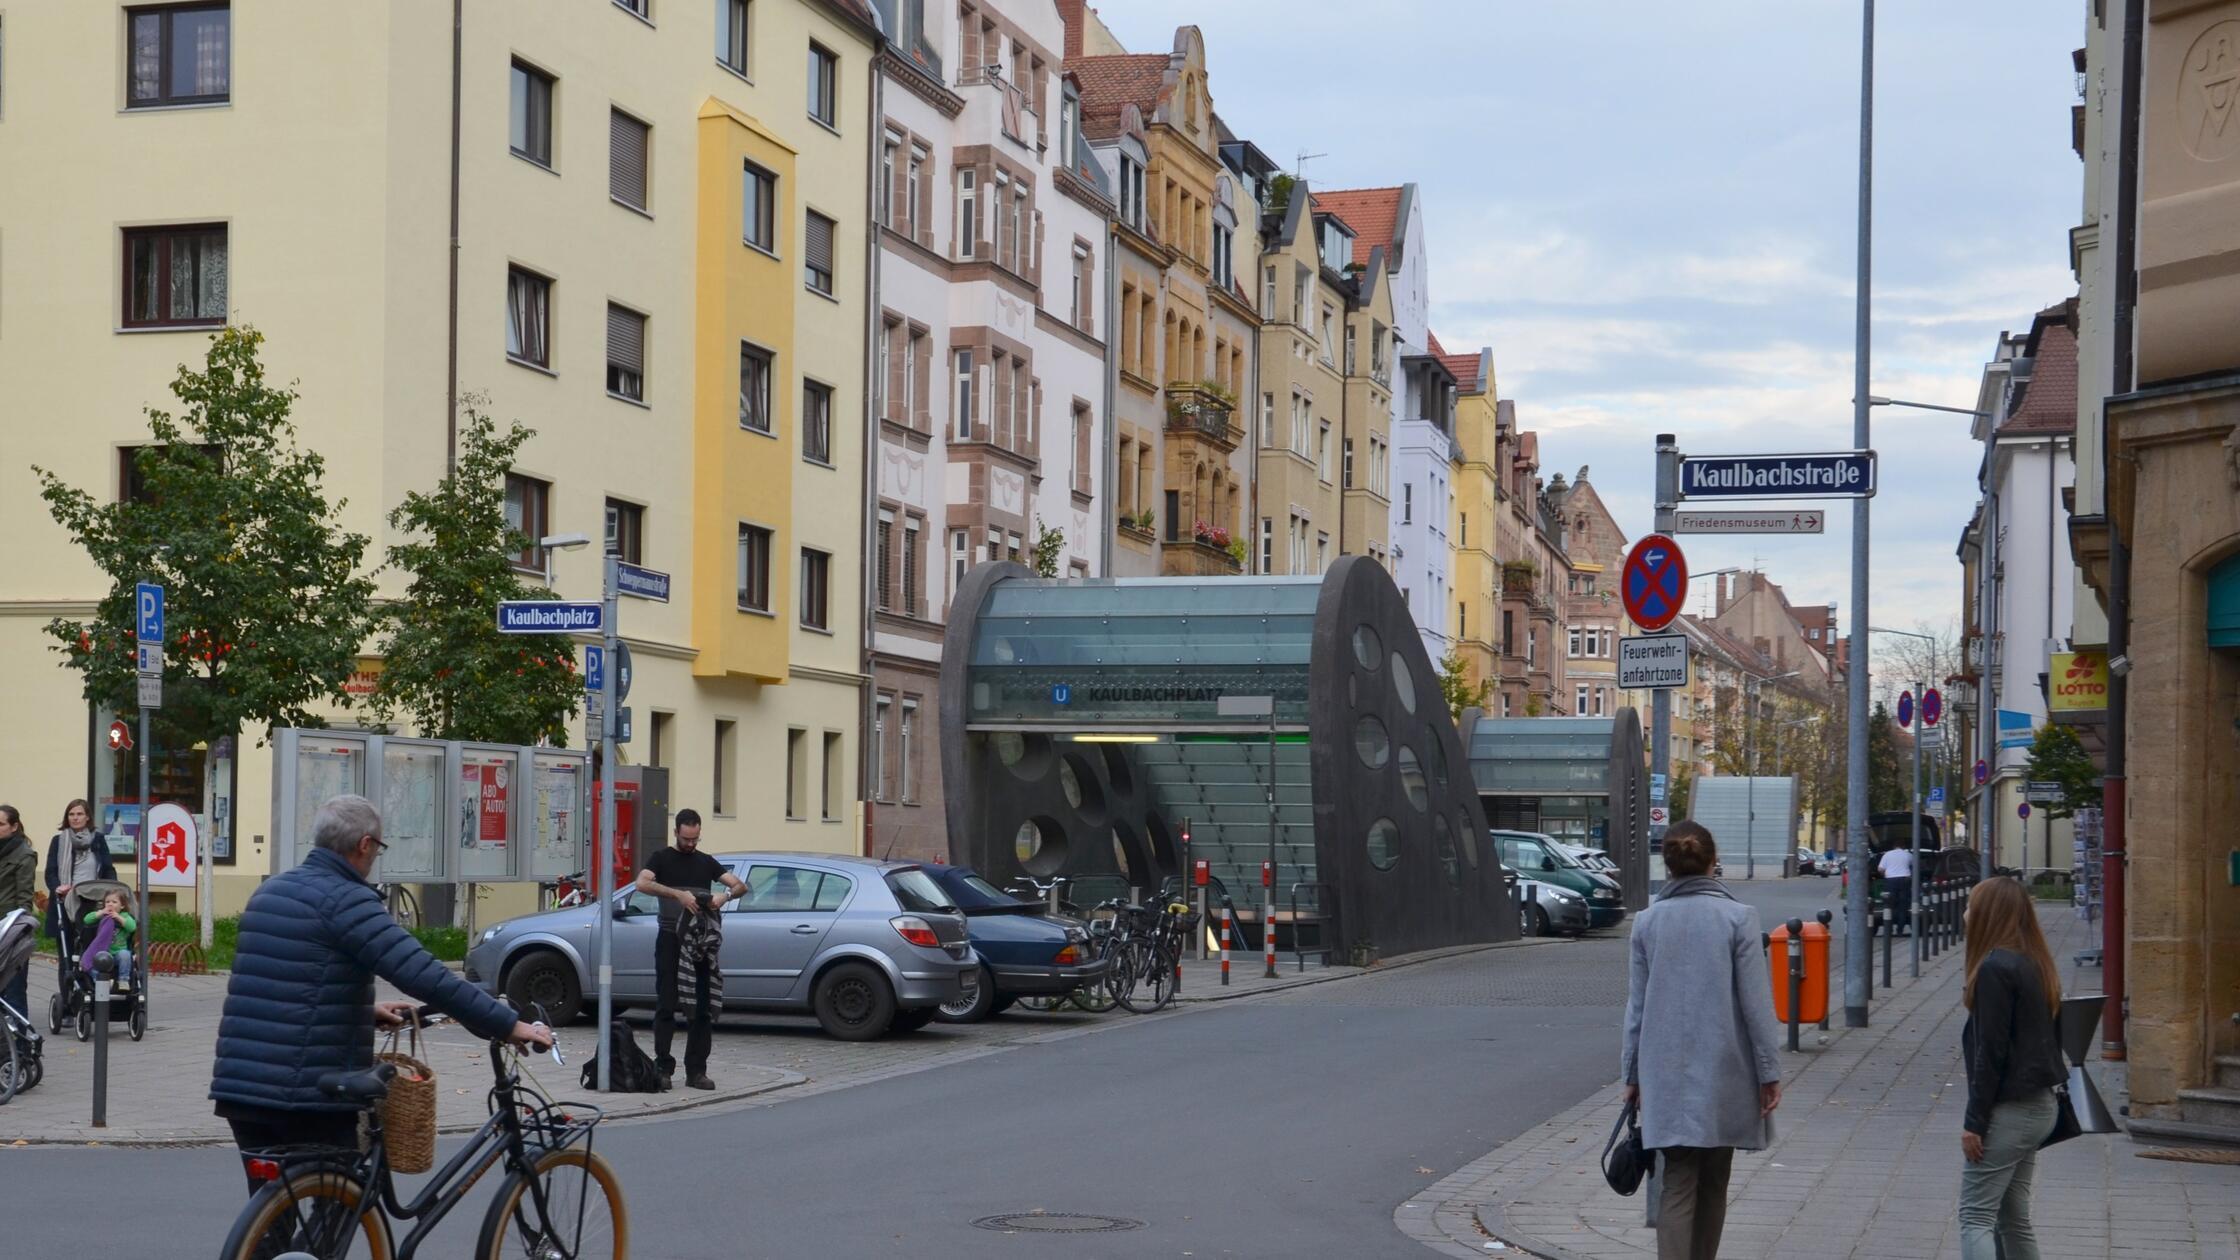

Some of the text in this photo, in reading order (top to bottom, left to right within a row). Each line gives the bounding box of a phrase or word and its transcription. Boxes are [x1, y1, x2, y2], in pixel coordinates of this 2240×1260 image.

[1692, 459, 1860, 488] Kaulbachstraße
[1682, 517, 1786, 529] Friedensmuseum
[141, 591, 155, 633] P
[507, 608, 595, 628] Kaulbachplatz
[1623, 642, 1682, 659] Feuerwehr-
[1623, 667, 1682, 683] anfahrtzone
[1089, 688, 1224, 702] KAULBACHPLATZ
[2057, 683, 2105, 696] LOTTO
[482, 784, 496, 798] ABO
